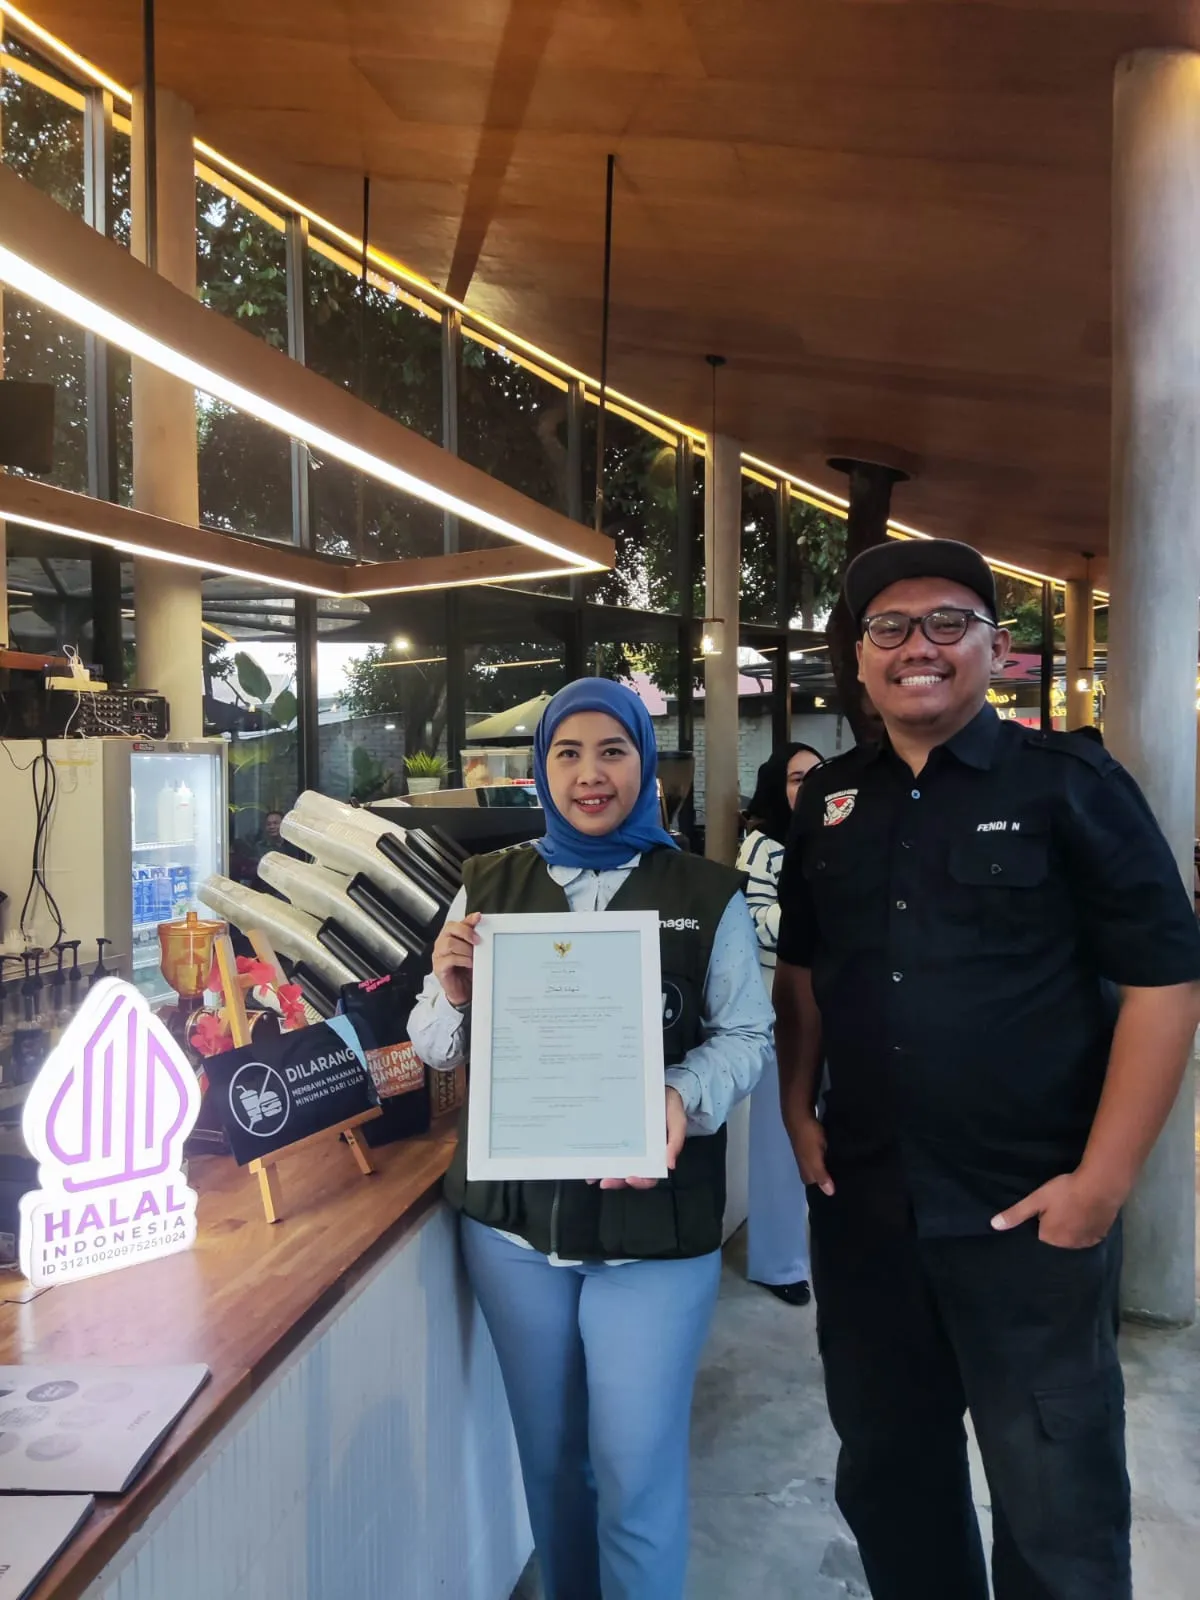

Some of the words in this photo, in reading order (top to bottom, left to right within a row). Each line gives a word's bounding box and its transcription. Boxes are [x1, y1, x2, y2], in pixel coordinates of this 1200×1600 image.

[977, 820, 1007, 832] FENDI
[1011, 821, 1020, 831] N
[285, 1047, 356, 1083] DILARANG
[372, 1059, 418, 1086] BANANA
[292, 1078, 327, 1097] MEMBAWA
[326, 1067, 356, 1084] MAKANAN
[295, 1088, 330, 1107] MINUMAN
[329, 1082, 347, 1093] DARI
[44, 1184, 186, 1242] HALAL
[42, 1215, 186, 1262] INDONESIA
[42, 1264, 56, 1276] ID
[60, 1230, 186, 1271] 31210020975251024
